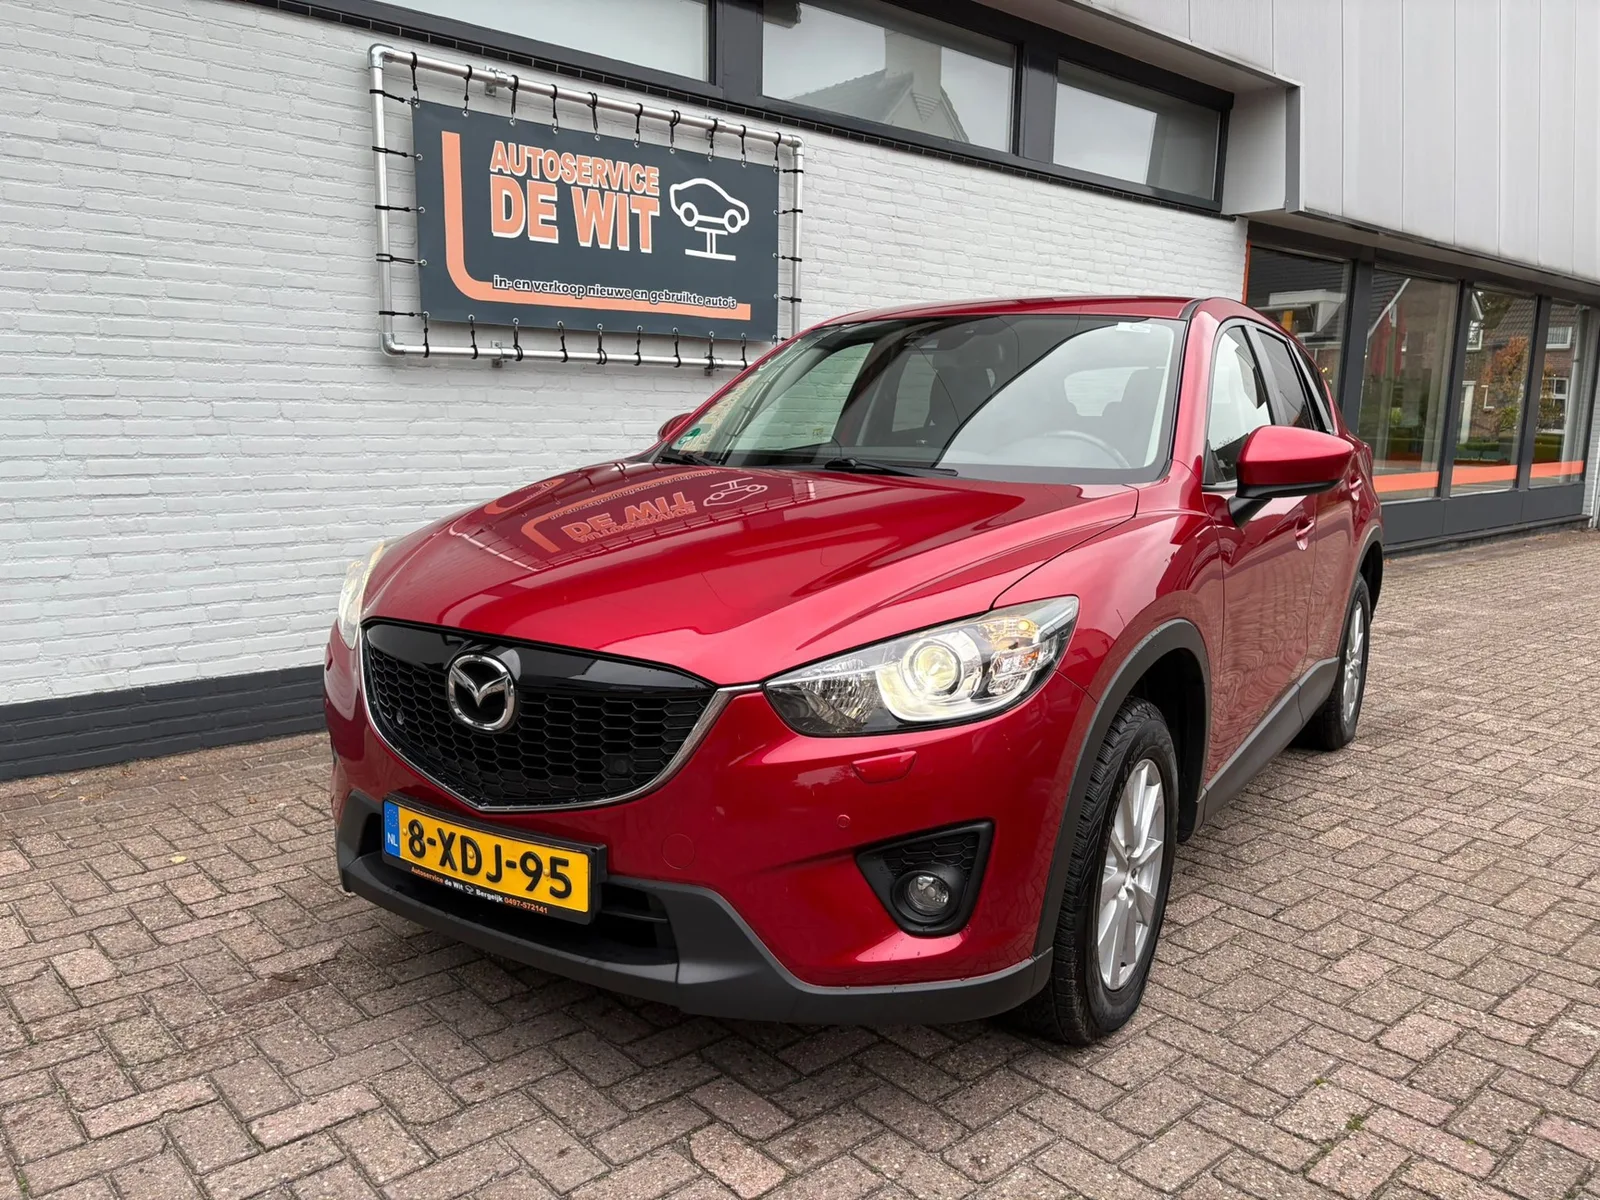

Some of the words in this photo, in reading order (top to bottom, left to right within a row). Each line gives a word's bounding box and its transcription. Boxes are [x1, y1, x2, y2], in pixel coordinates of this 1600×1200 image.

[490, 140, 660, 196] AUTOSERVICE
[490, 174, 559, 244] DE
[571, 186, 660, 254] WIT
[513, 279, 532, 292] en
[533, 280, 586, 299] verkoop
[587, 284, 632, 299] nieuwe
[633, 289, 648, 300] en
[649, 289, 704, 305] gebruikte
[704, 296, 737, 309] auto's
[387, 832, 398, 847] NL
[408, 819, 572, 899] 8-XDJ-95
[411, 866, 444, 884] Autoservice
[444, 879, 453, 888] de
[453, 881, 464, 891] Wit
[476, 889, 503, 903] Bergeijk
[504, 897, 548, 914] 0497-572141
